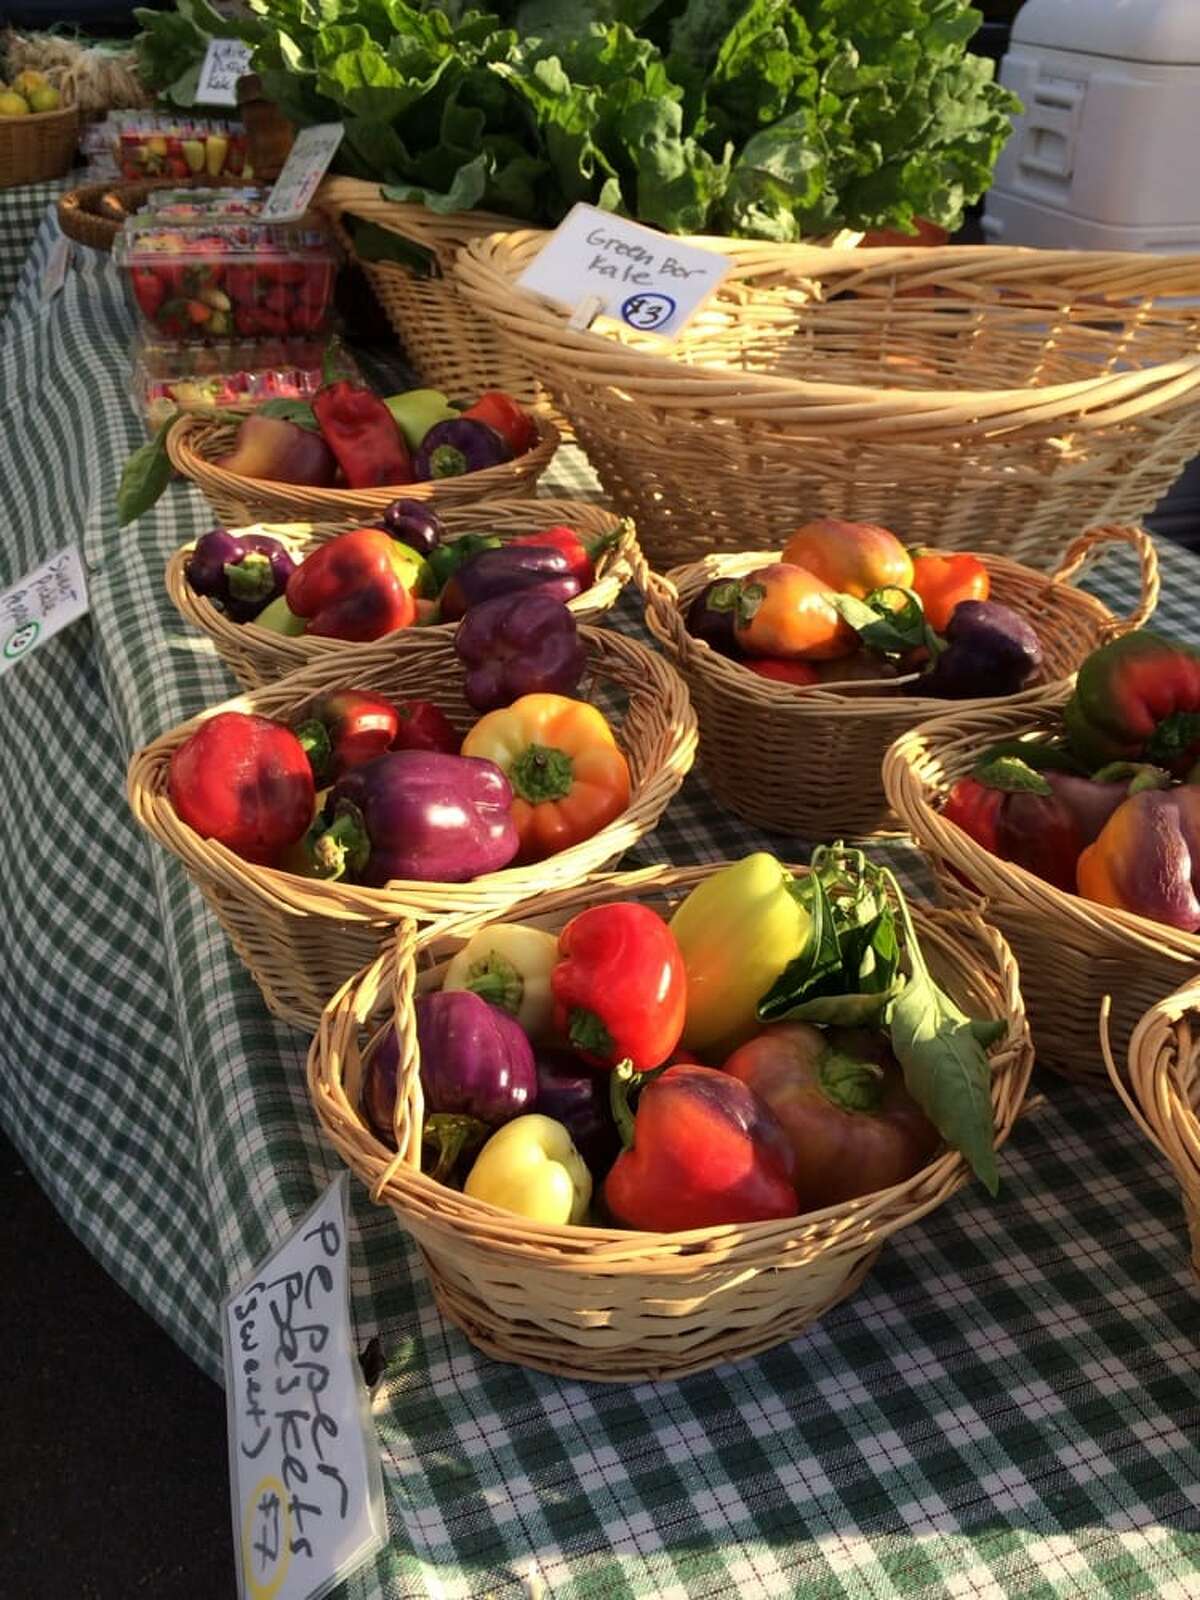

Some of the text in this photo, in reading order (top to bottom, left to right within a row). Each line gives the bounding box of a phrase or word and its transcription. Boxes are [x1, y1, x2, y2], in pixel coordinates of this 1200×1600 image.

[586, 228, 654, 265] Green
[588, 255, 654, 286] Kale
[627, 299, 663, 325] $3
[304, 1221, 348, 1519] Pepper
[268, 1271, 322, 1558] Baskets
[254, 1493, 280, 1571] $7
